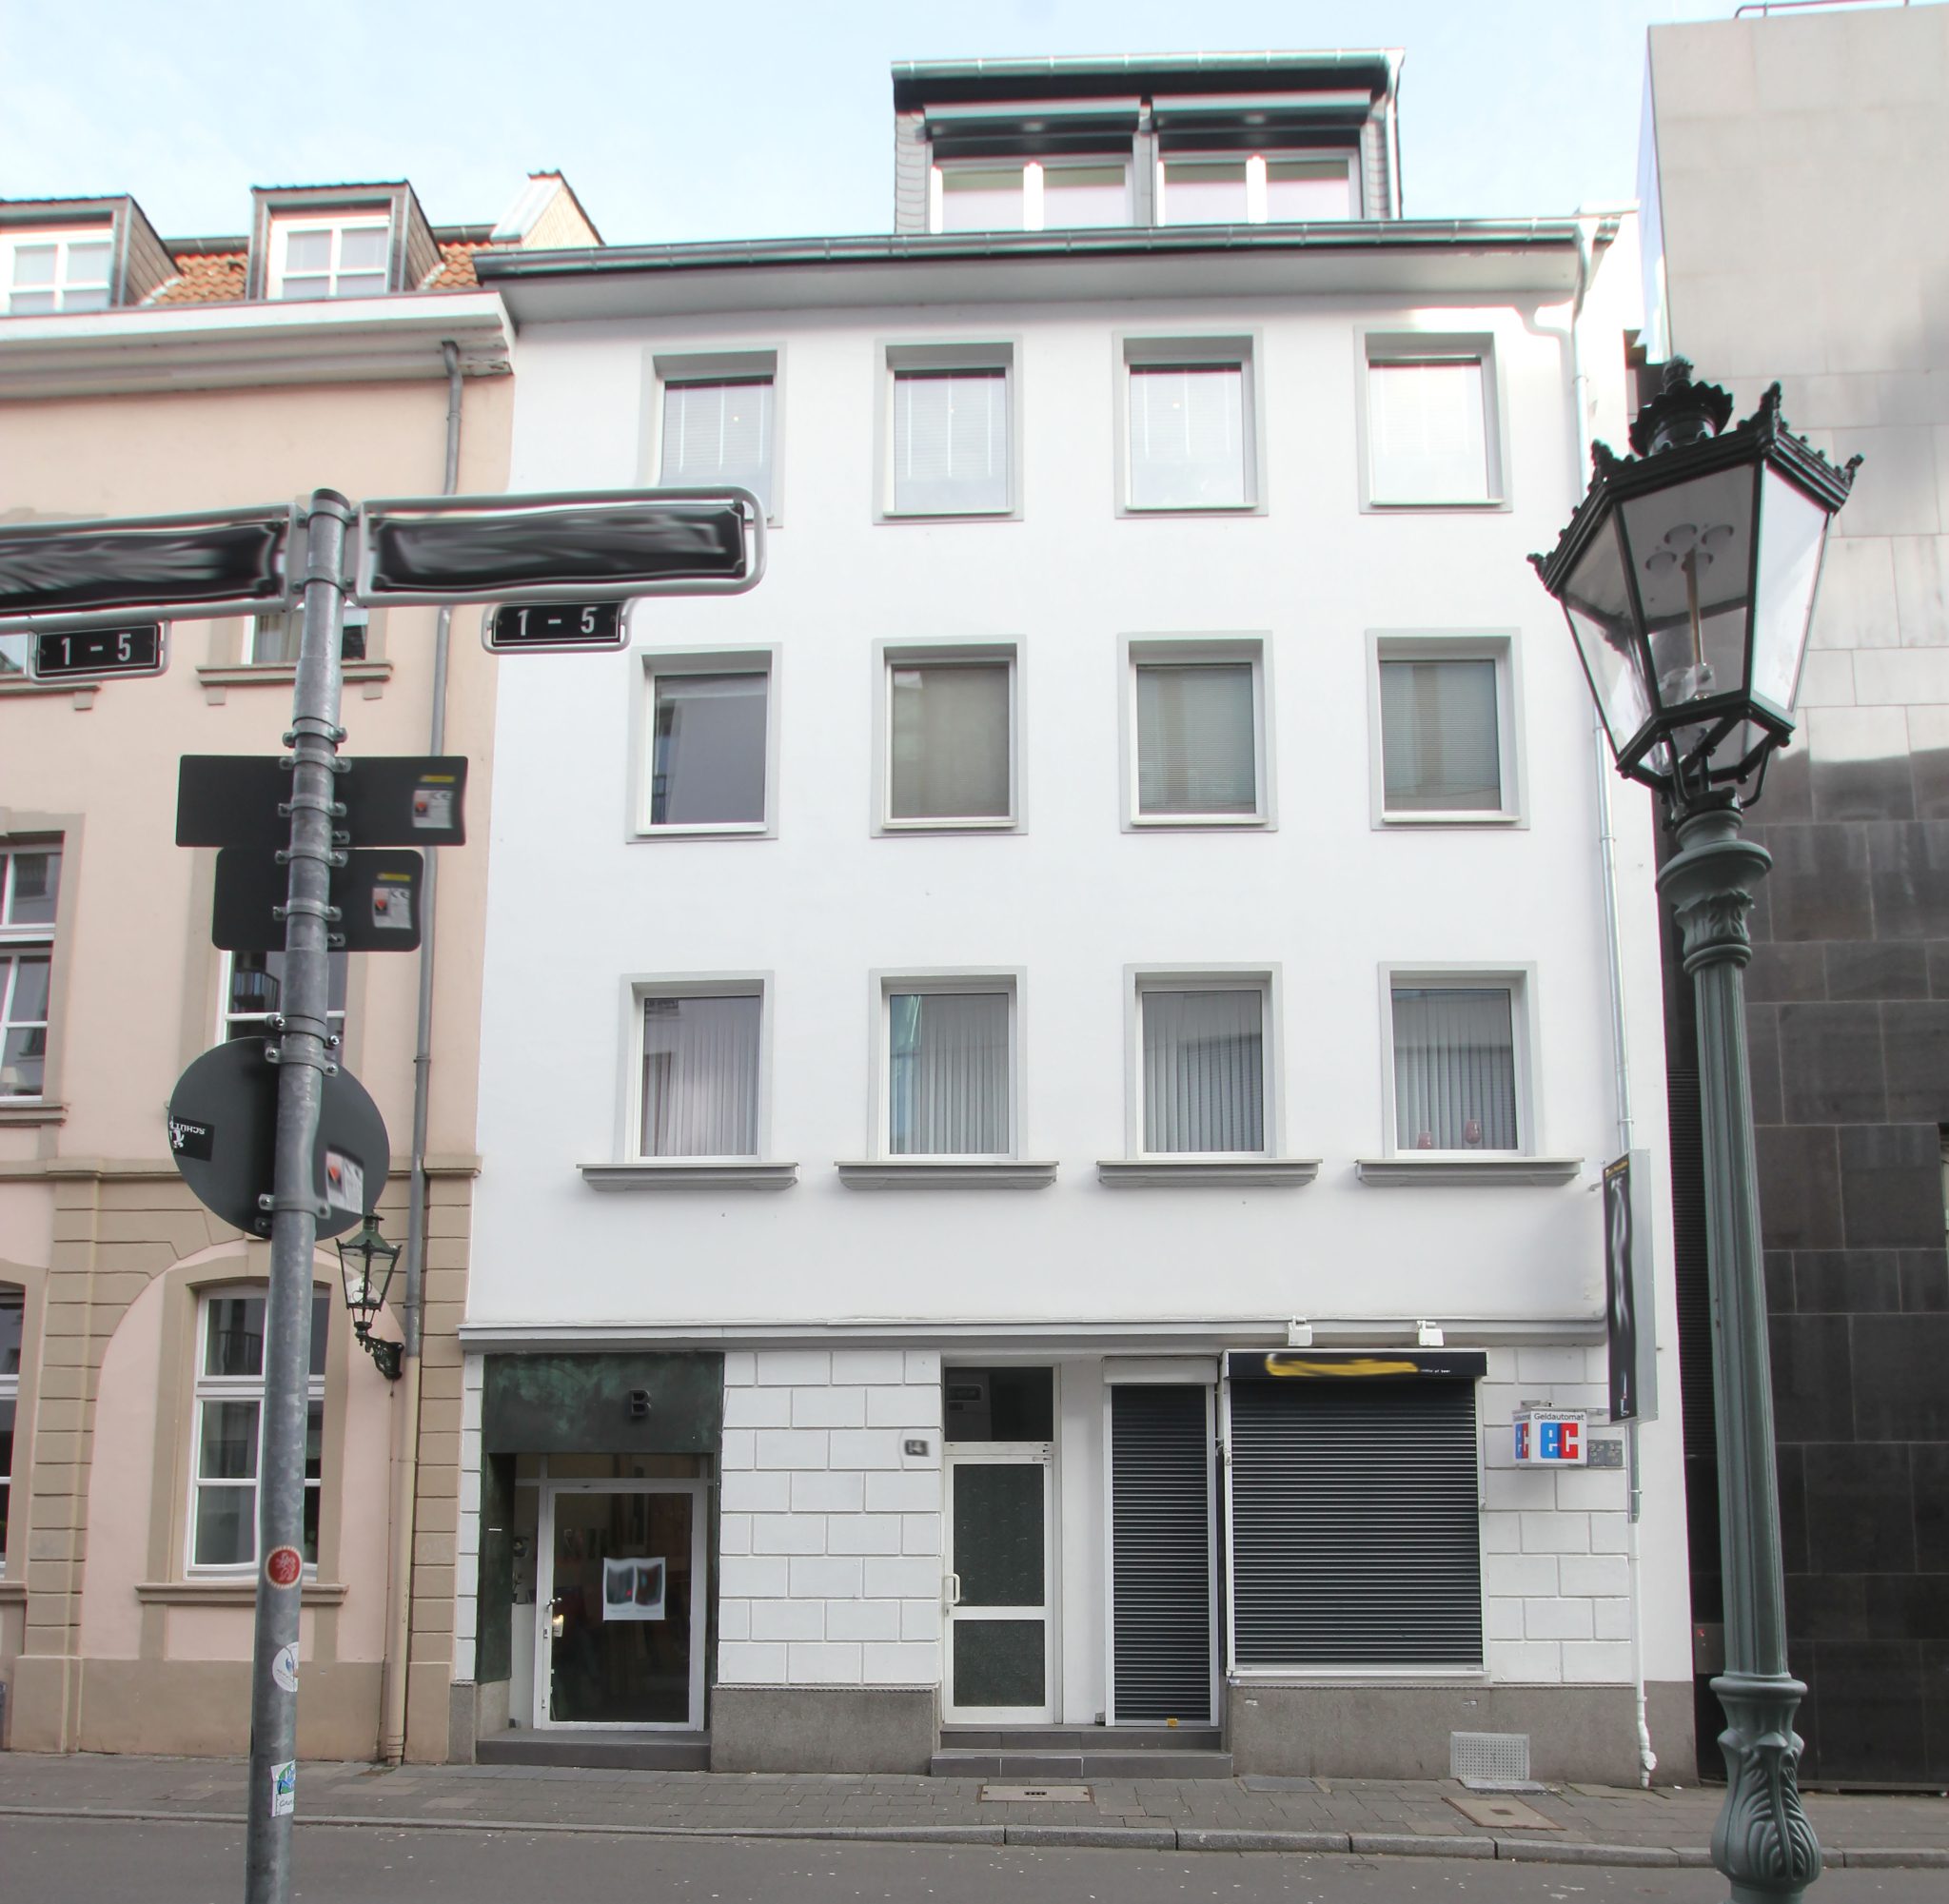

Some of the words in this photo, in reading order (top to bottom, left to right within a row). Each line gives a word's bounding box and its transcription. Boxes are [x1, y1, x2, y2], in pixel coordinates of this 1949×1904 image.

[517, 609, 529, 637] 1
[580, 606, 598, 634] 5
[61, 637, 71, 666] 1
[117, 633, 132, 662] 5
[628, 1389, 651, 1417] B
[1533, 1412, 1585, 1421] Geldautomat
